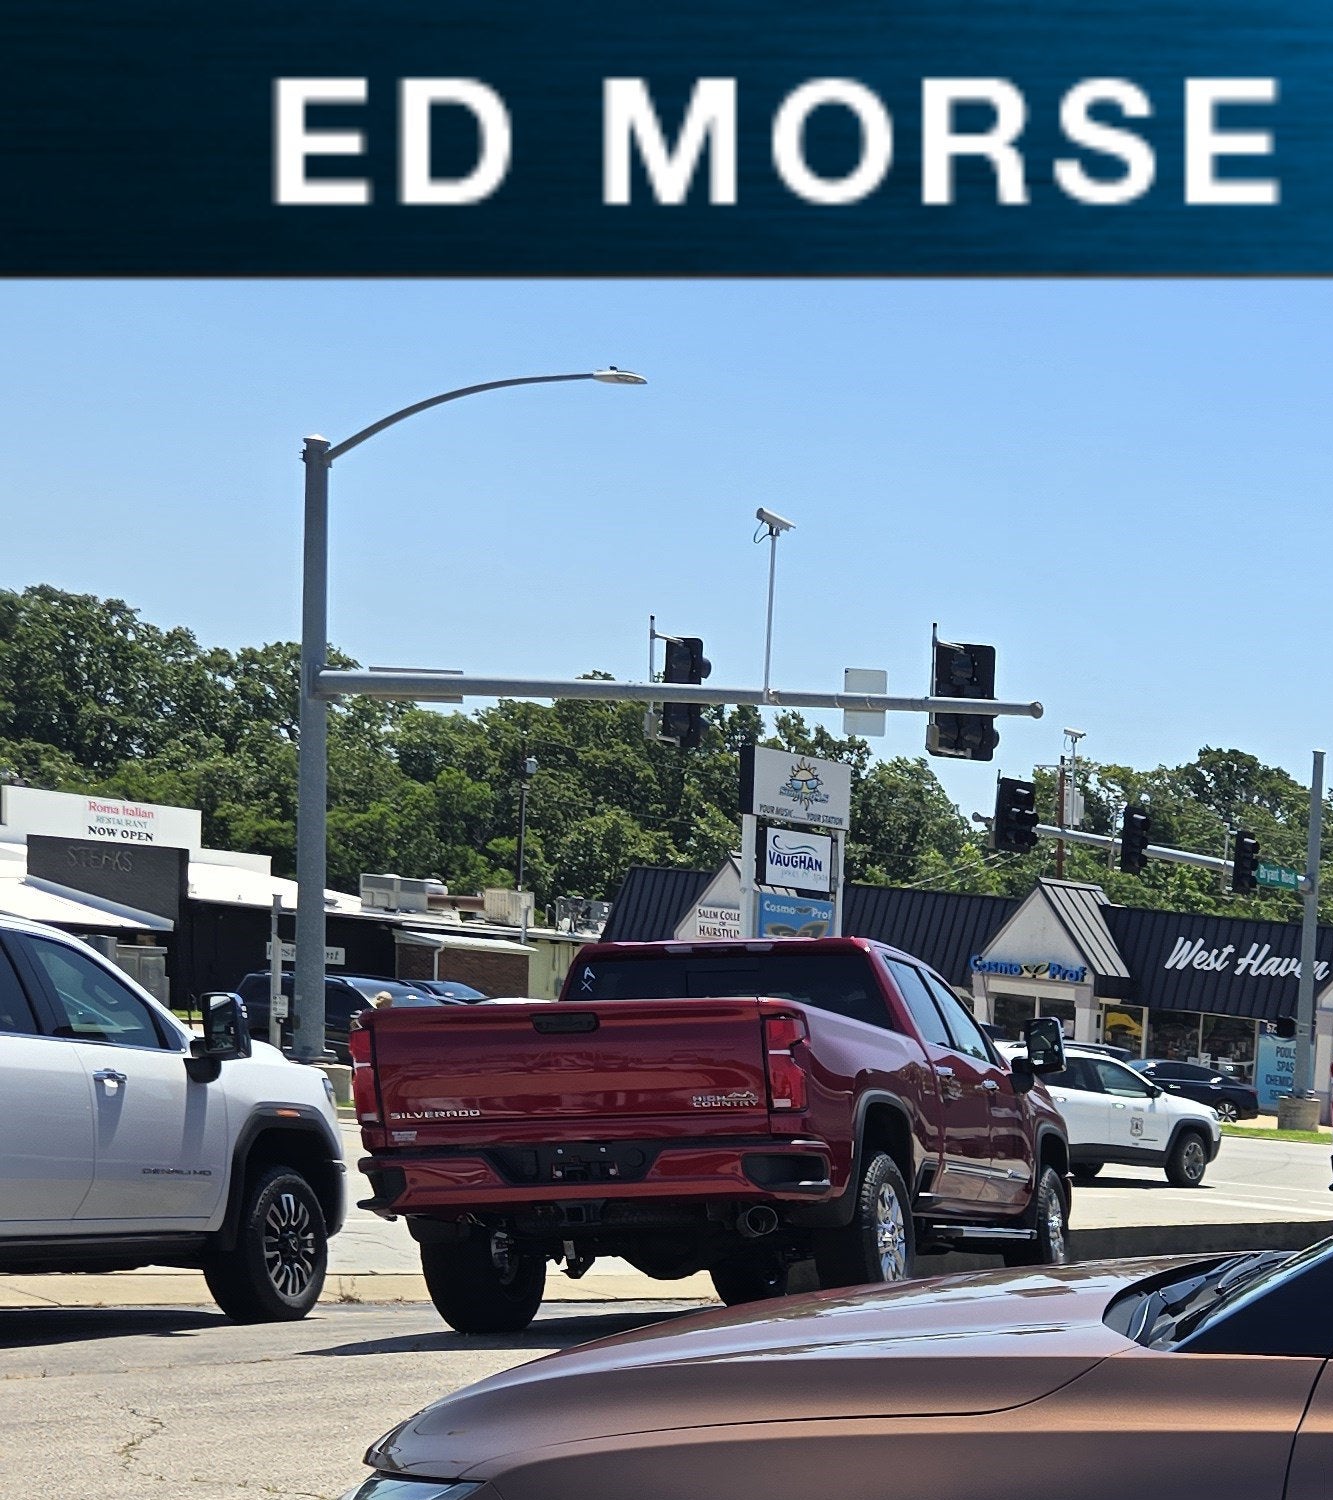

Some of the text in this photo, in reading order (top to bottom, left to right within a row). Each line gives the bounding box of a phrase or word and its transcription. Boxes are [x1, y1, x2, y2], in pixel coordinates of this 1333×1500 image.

[88, 801, 154, 819] Roma Italian
[87, 825, 153, 842] NOW OPEN
[768, 850, 823, 872] VAUGHAN
[698, 908, 740, 921] SALEM COLLE
[764, 900, 833, 920] Cosmo Prof
[1164, 936, 1330, 981] West Havn
[970, 955, 1087, 982] Cosmo Prof
[1276, 1061, 1295, 1073] SPAS
[1266, 1074, 1295, 1087] CHEMIC
[692, 1098, 759, 1108] COUNTRY
[390, 1109, 481, 1120] SILVERADO
